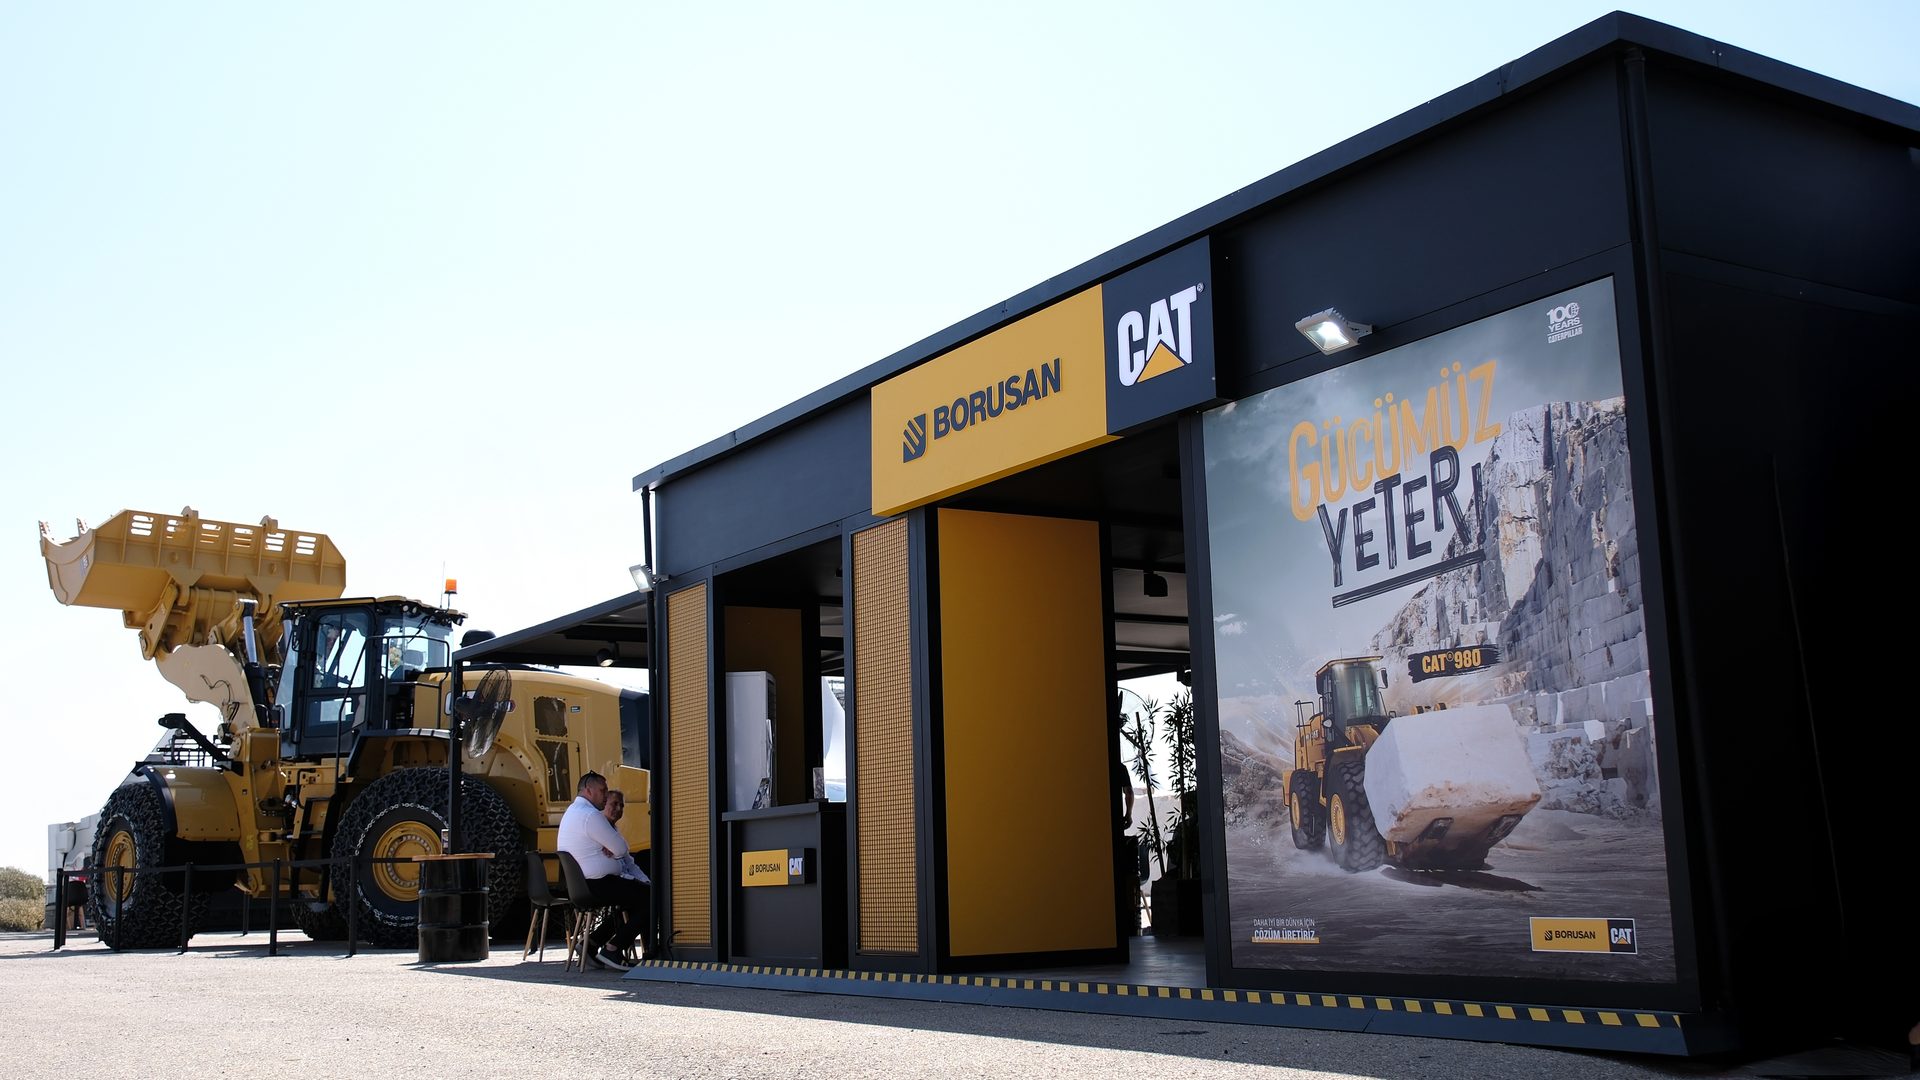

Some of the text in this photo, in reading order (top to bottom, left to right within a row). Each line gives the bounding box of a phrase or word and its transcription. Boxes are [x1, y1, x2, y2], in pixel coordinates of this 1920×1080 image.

[1546, 302, 1580, 325] 100
[1548, 317, 1581, 332] YEARS
[1547, 327, 1583, 343] CATERPILLAR
[933, 358, 1062, 440] BORUSAN
[1288, 360, 1503, 522] GÜCÜMÜZ
[1316, 445, 1487, 588] YETER!
[1454, 648, 1482, 669] 980
[755, 863, 781, 873] BORUSAN
[789, 857, 803, 875] CAT
[1253, 918, 1268, 927] DAHA
[1285, 917, 1304, 927] DÜNYA
[1254, 928, 1315, 941] ÇÖZÜM ÜRETİRİZ
[1554, 930, 1596, 940] BORUSAN
[1610, 927, 1632, 945] CAT
